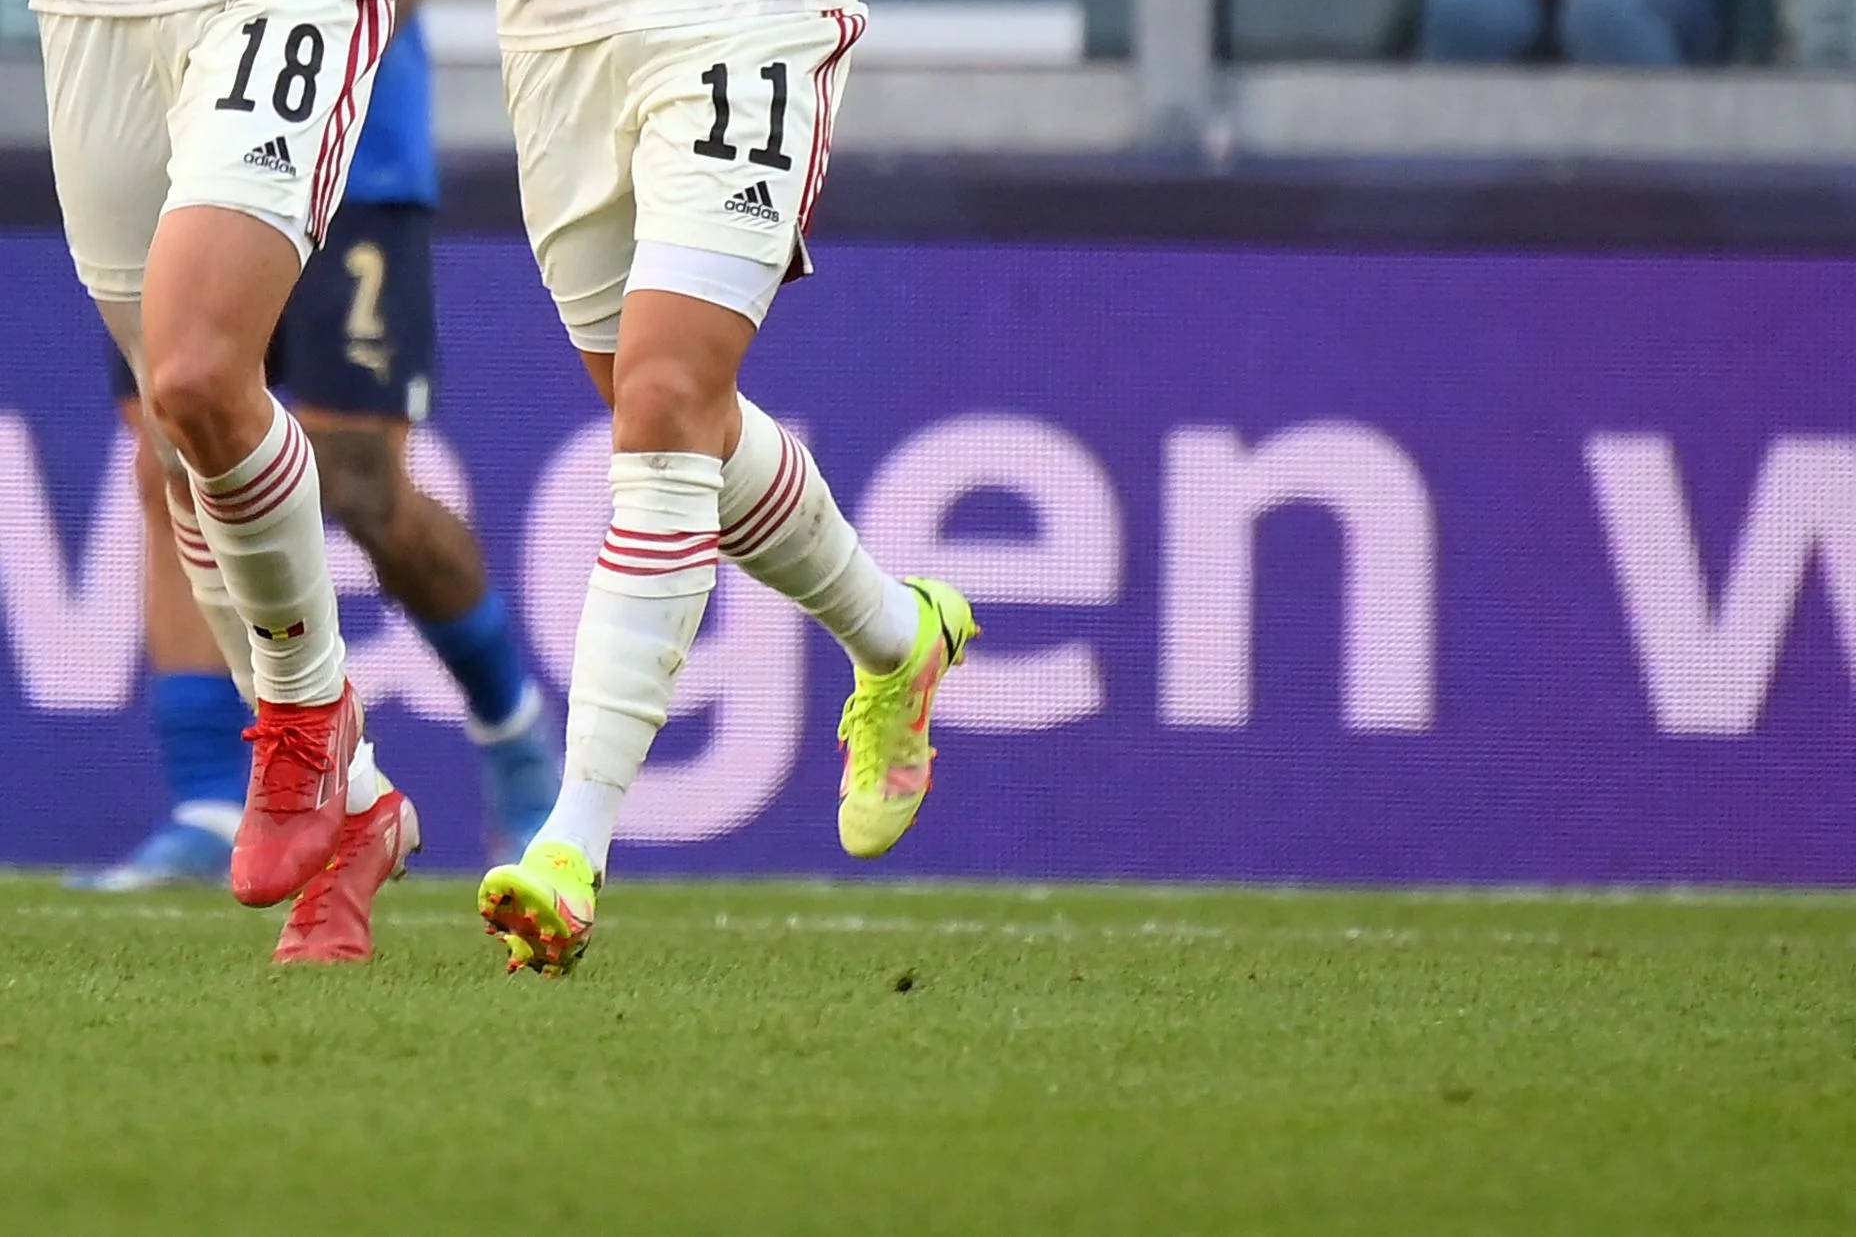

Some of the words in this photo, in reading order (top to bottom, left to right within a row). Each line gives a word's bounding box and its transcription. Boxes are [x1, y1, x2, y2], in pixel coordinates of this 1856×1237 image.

[215, 17, 325, 122] 18
[693, 62, 792, 171] 11
[724, 200, 780, 222] adidas
[345, 241, 385, 339] 2
